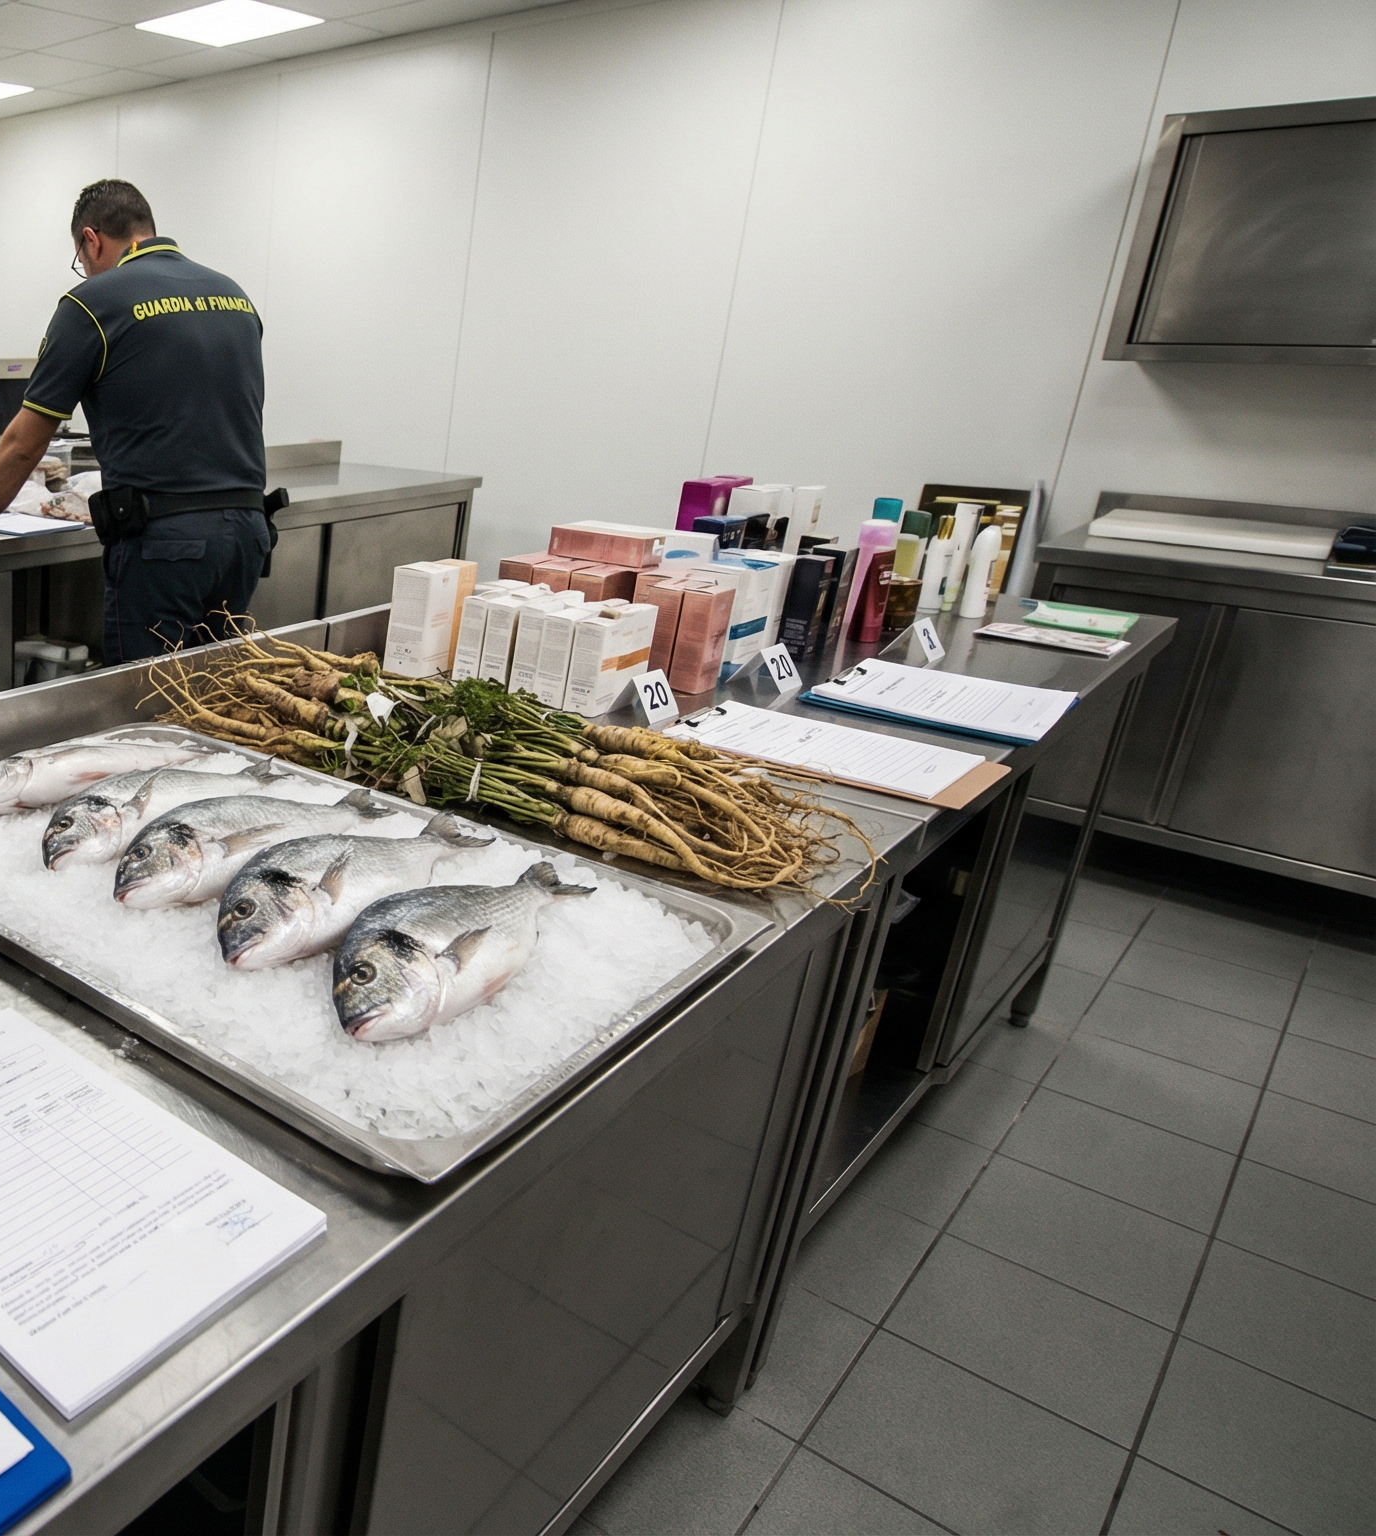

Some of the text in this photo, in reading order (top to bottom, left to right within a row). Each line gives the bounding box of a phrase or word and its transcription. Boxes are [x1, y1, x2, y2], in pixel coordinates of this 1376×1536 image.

[133, 296, 255, 321] GUARDIA di FINANZA
[770, 654, 793, 681] 20
[644, 681, 669, 710] 20
